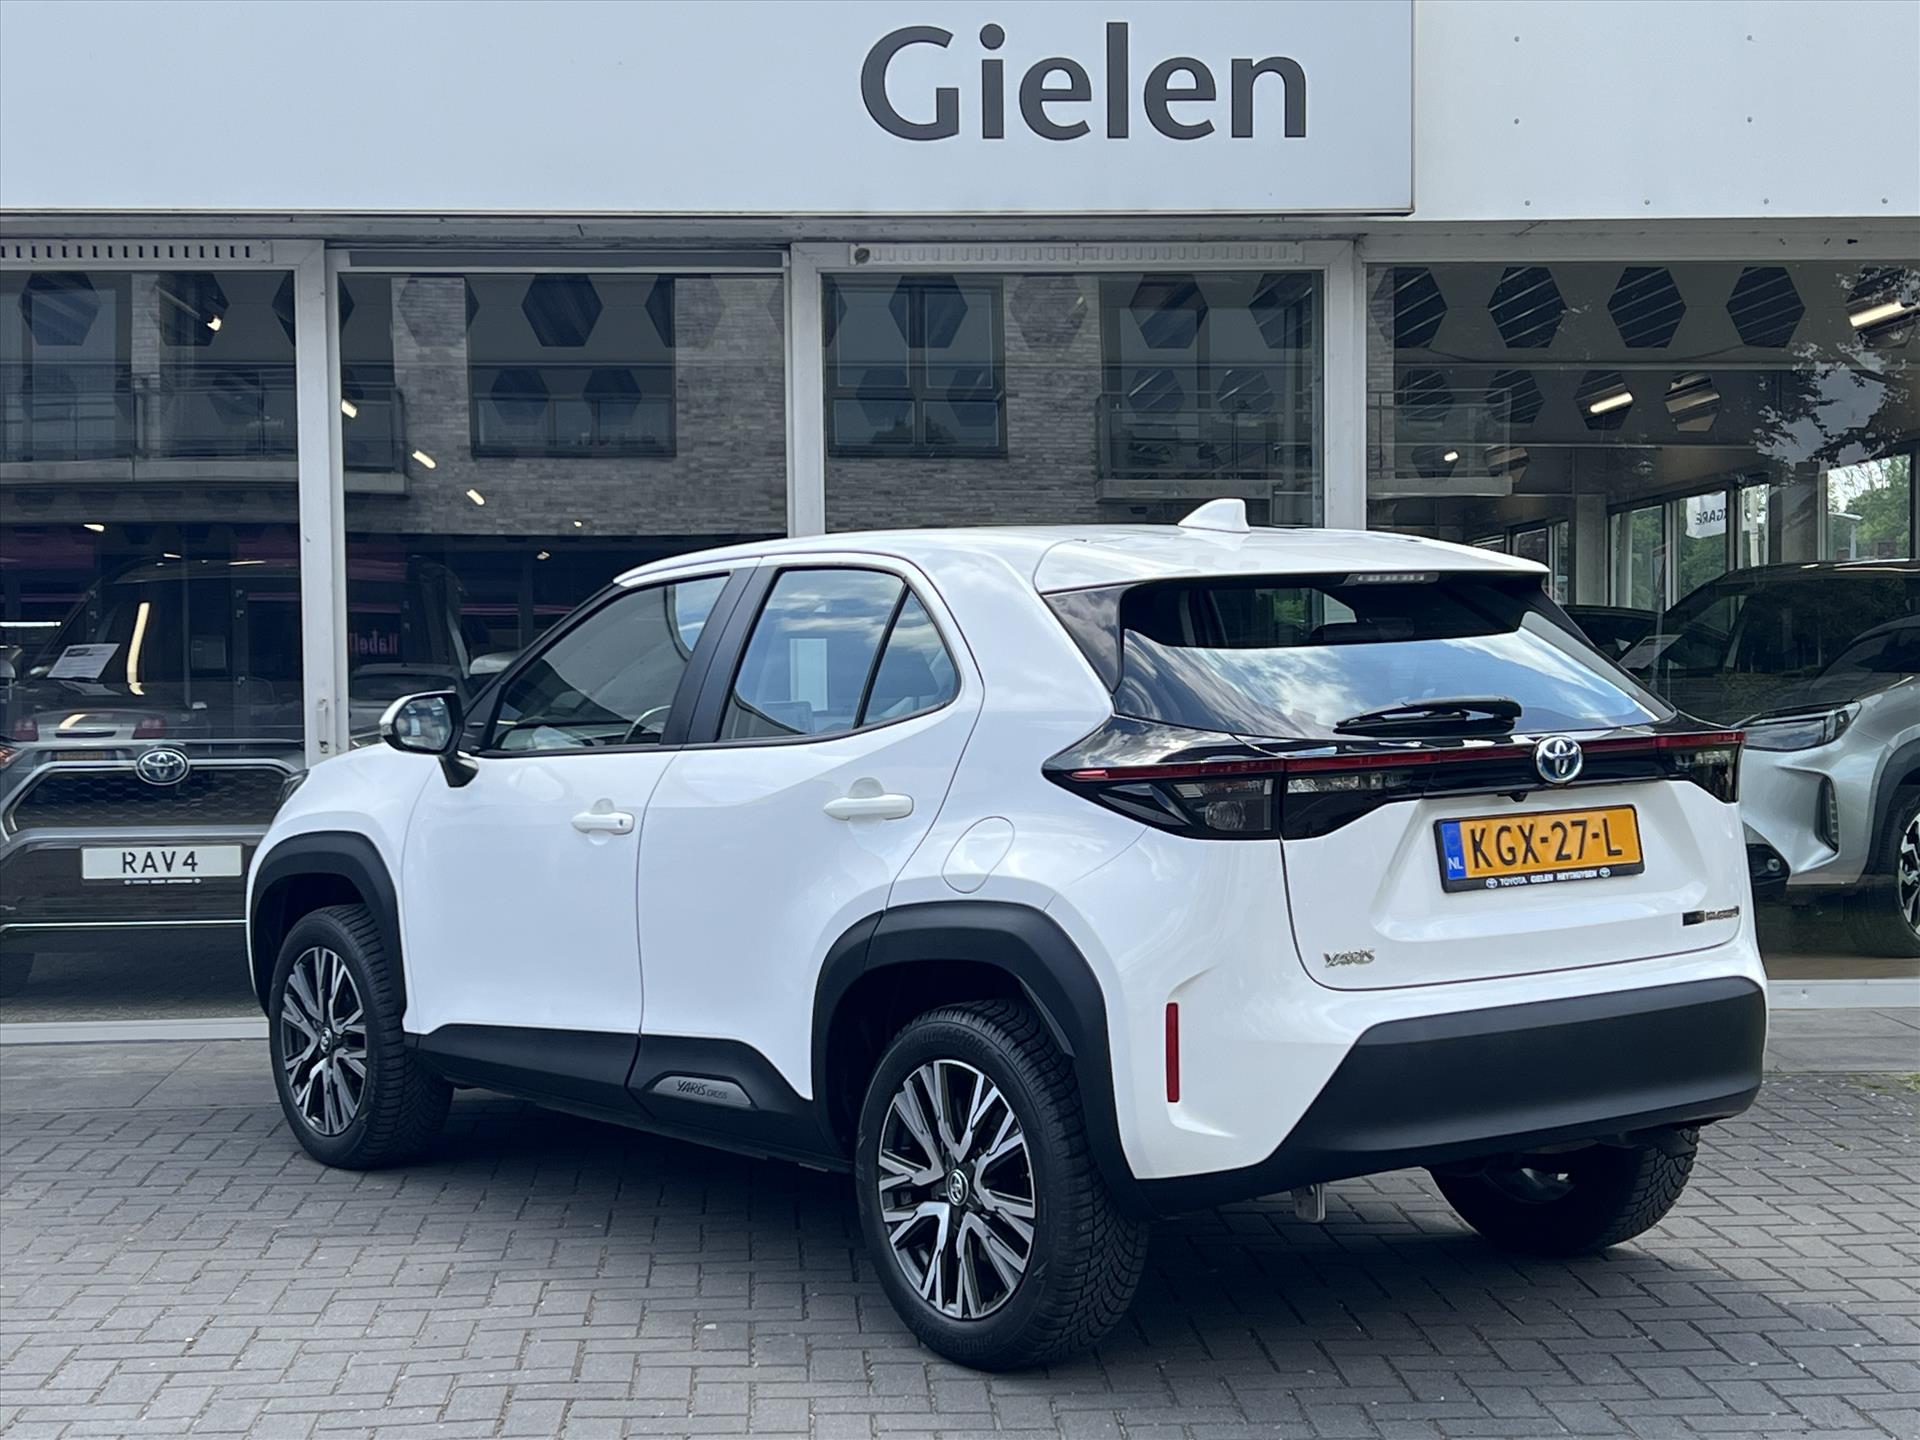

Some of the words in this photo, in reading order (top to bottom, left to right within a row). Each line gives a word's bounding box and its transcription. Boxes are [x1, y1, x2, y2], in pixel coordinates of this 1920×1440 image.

[860, 22, 1306, 141] Gielen
[1469, 818, 1623, 869] KGX-27-L
[121, 850, 199, 873] RAV4
[1447, 857, 1465, 871] NL
[1500, 876, 1528, 887] TOYOTA
[676, 1079, 709, 1096] YARIS
